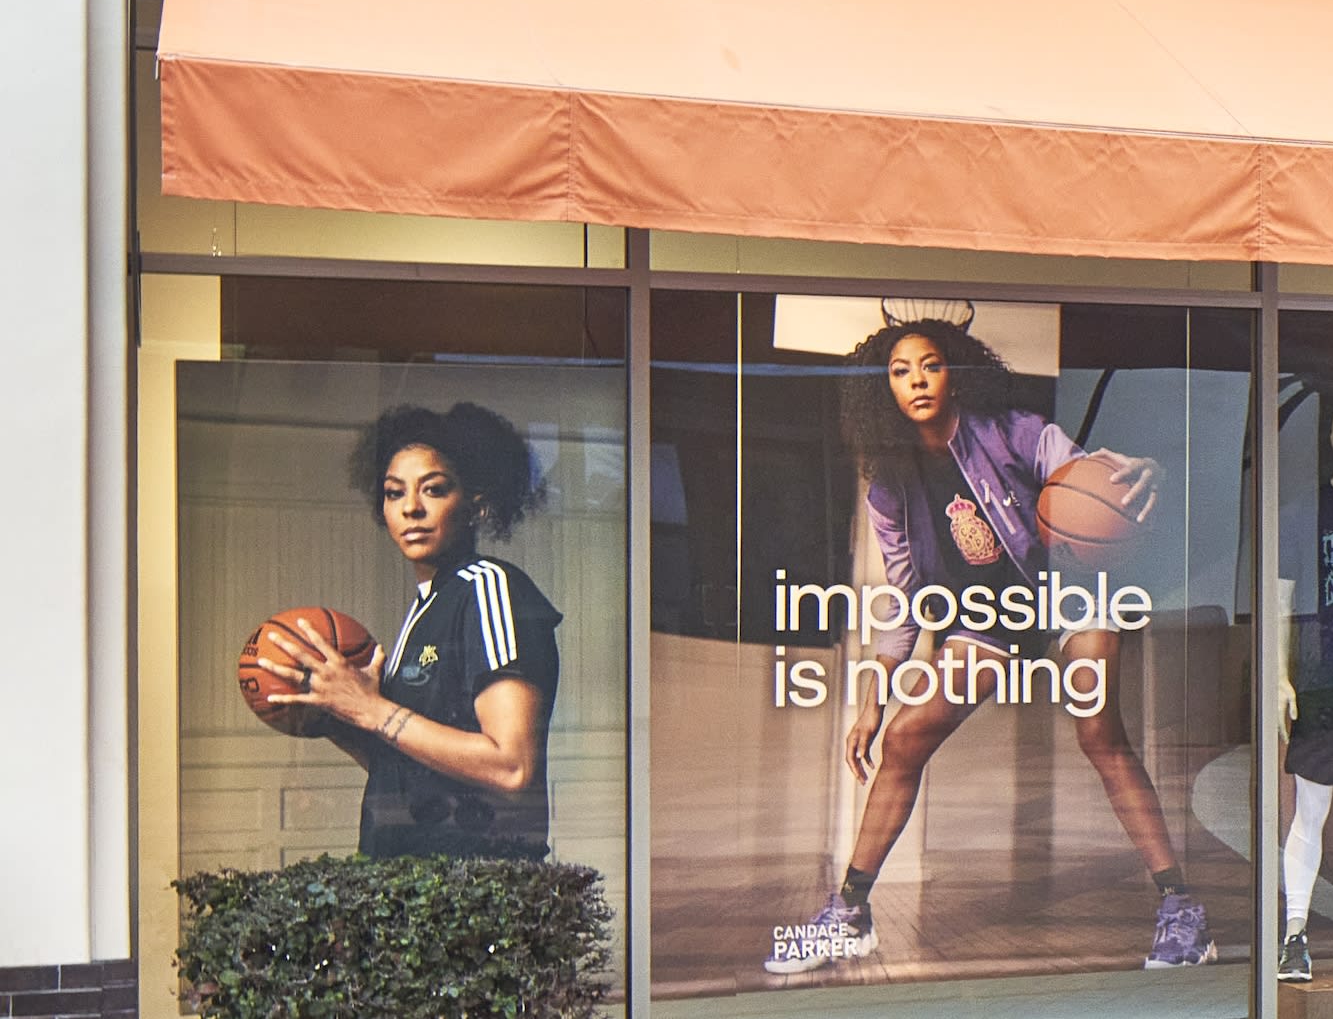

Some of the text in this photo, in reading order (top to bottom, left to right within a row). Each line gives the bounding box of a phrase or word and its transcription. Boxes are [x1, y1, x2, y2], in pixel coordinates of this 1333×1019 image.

[775, 569, 1152, 645] impossible
[775, 644, 1106, 718] is nothing
[774, 923, 848, 940] CANDACE
[774, 938, 857, 960] PARKER
